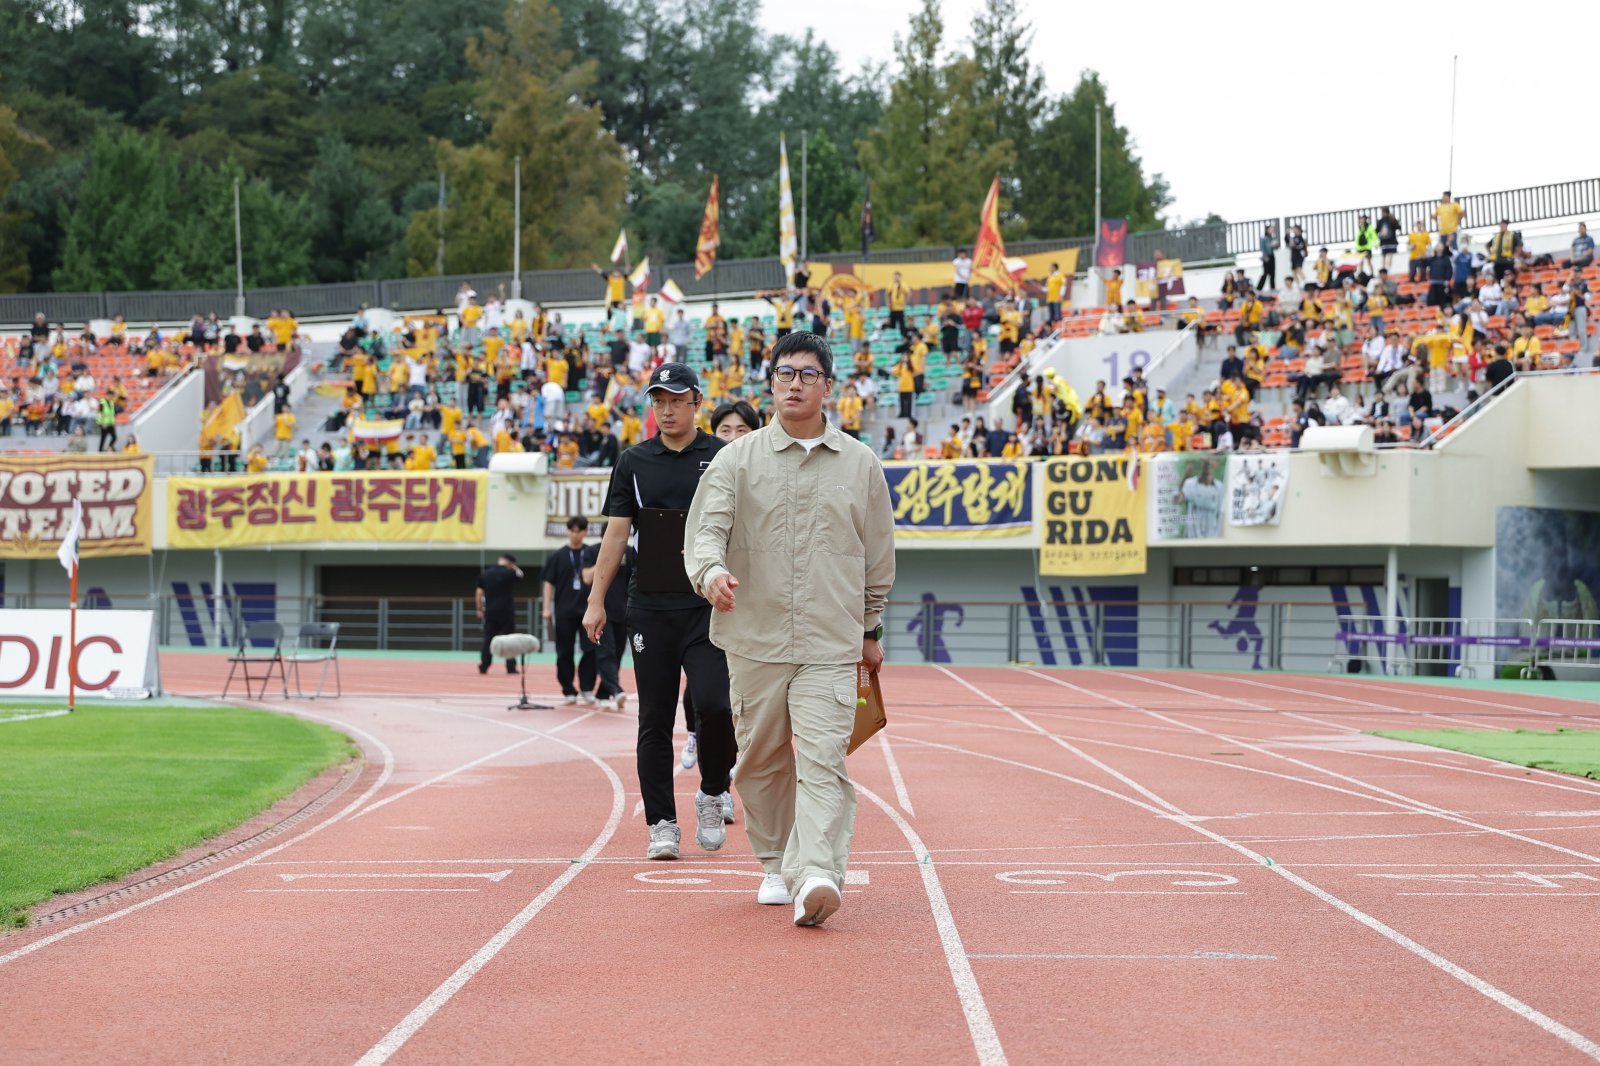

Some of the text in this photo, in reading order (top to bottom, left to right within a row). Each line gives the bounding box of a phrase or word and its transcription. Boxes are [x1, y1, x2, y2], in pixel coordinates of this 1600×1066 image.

[176, 478, 477, 530] 광주정신 광주답게
[1047, 491, 1093, 516] GU
[0, 504, 137, 540] TEAM
[1046, 518, 1133, 545] RIDA
[0, 635, 123, 691] DIC
